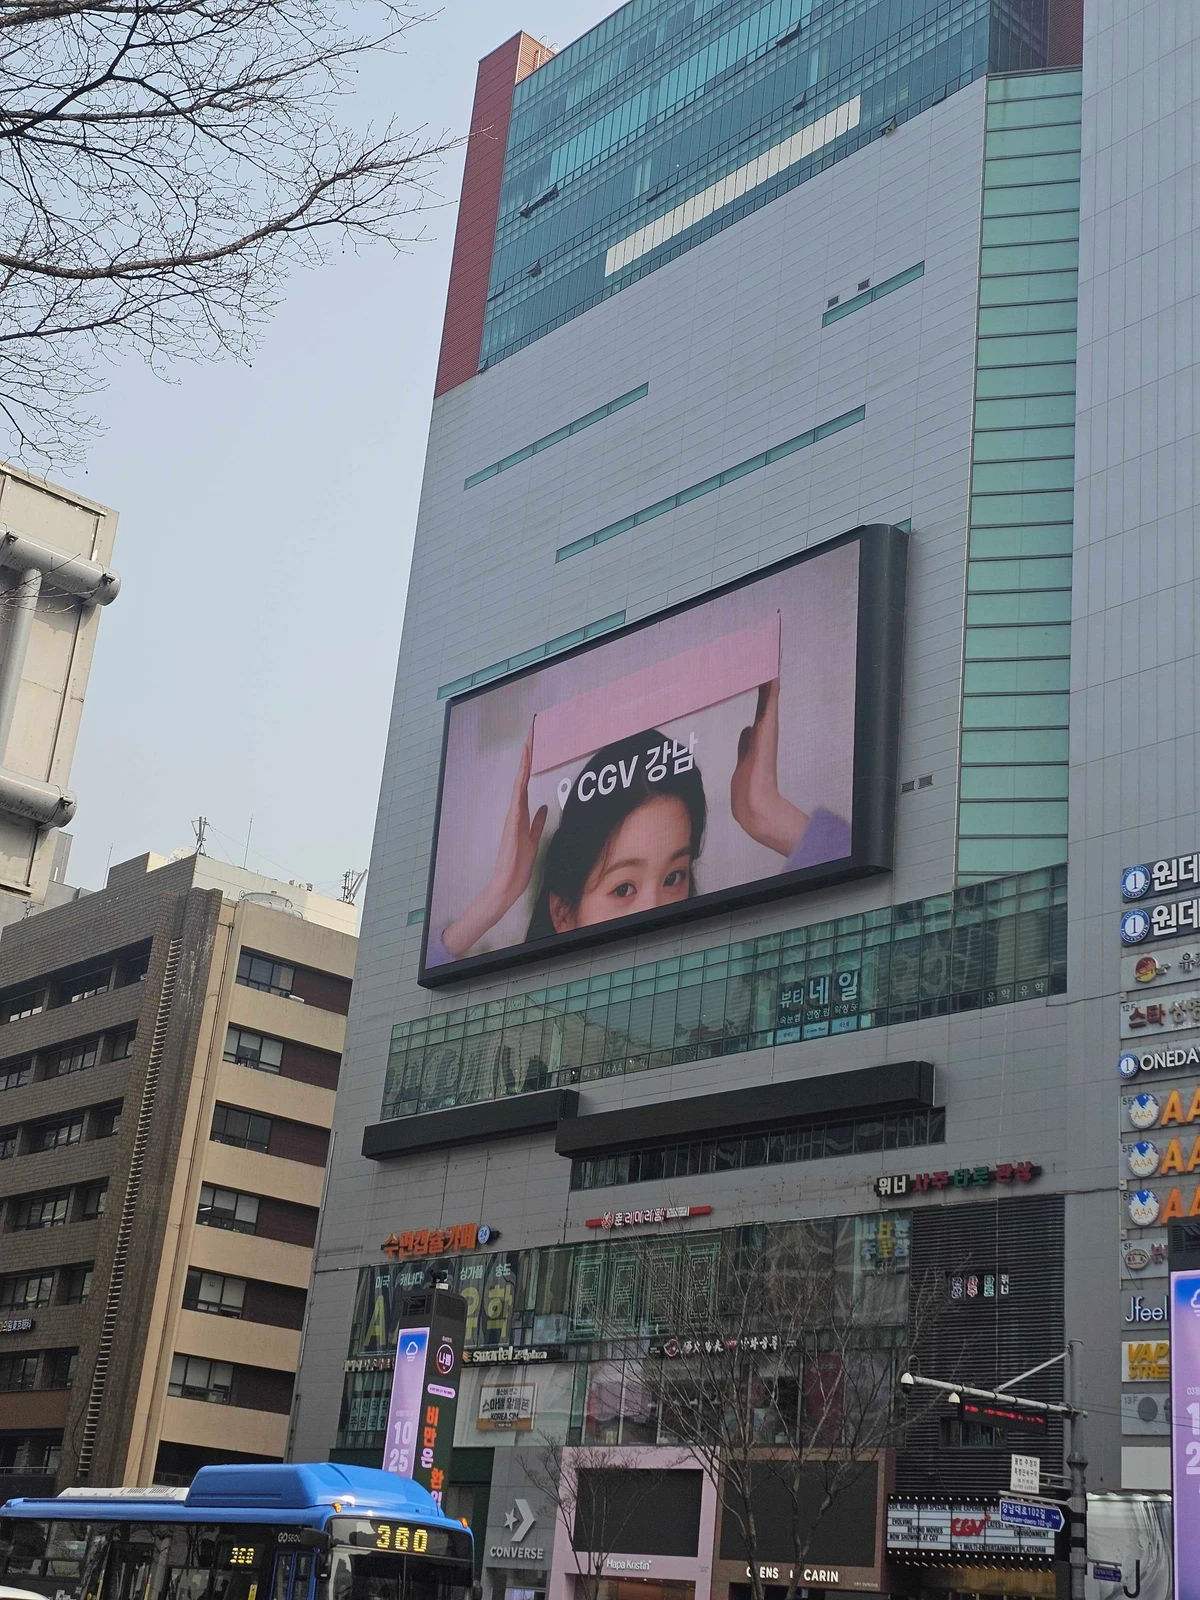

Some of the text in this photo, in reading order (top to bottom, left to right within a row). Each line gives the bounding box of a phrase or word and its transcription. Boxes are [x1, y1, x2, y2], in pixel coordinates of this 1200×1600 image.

[577, 731, 698, 802] CGV 강남
[780, 971, 859, 1009] 뷰티 네일
[1129, 1004, 1166, 1029] 스타
[1140, 1047, 1200, 1071] ONEDA
[1134, 1110, 1154, 1120] AAA
[1133, 1158, 1154, 1168] AAA
[878, 1175, 906, 1196] 위너
[913, 1171, 949, 1193] 사주
[954, 1166, 989, 1189] 타로
[1134, 1207, 1154, 1217] AAA
[384, 1222, 478, 1258] 수면캡슐카페
[479, 1229, 488, 1238] 24
[375, 1275, 390, 1289] 미국
[495, 1263, 512, 1277] 송도
[439, 1352, 452, 1366] 나쁨
[473, 1346, 513, 1362] smartel
[1128, 1343, 1170, 1364] VAP
[490, 1412, 508, 1421] KOREA
[394, 1421, 413, 1445] 10
[388, 1448, 409, 1473] 25
[1002, 1502, 1046, 1520] 강남대로102길
[1002, 1514, 1037, 1526] Gangnam-daero
[951, 1517, 987, 1537] CGV
[1013, 1530, 1049, 1538] ENVIRONMENT
[278, 1532, 288, 1543] GO
[376, 1525, 428, 1553] 360
[230, 1547, 255, 1565] 360
[490, 1546, 544, 1559] CONVERSE
[606, 1558, 650, 1570] Hapa Kristin
[803, 1568, 839, 1583] CARIN
